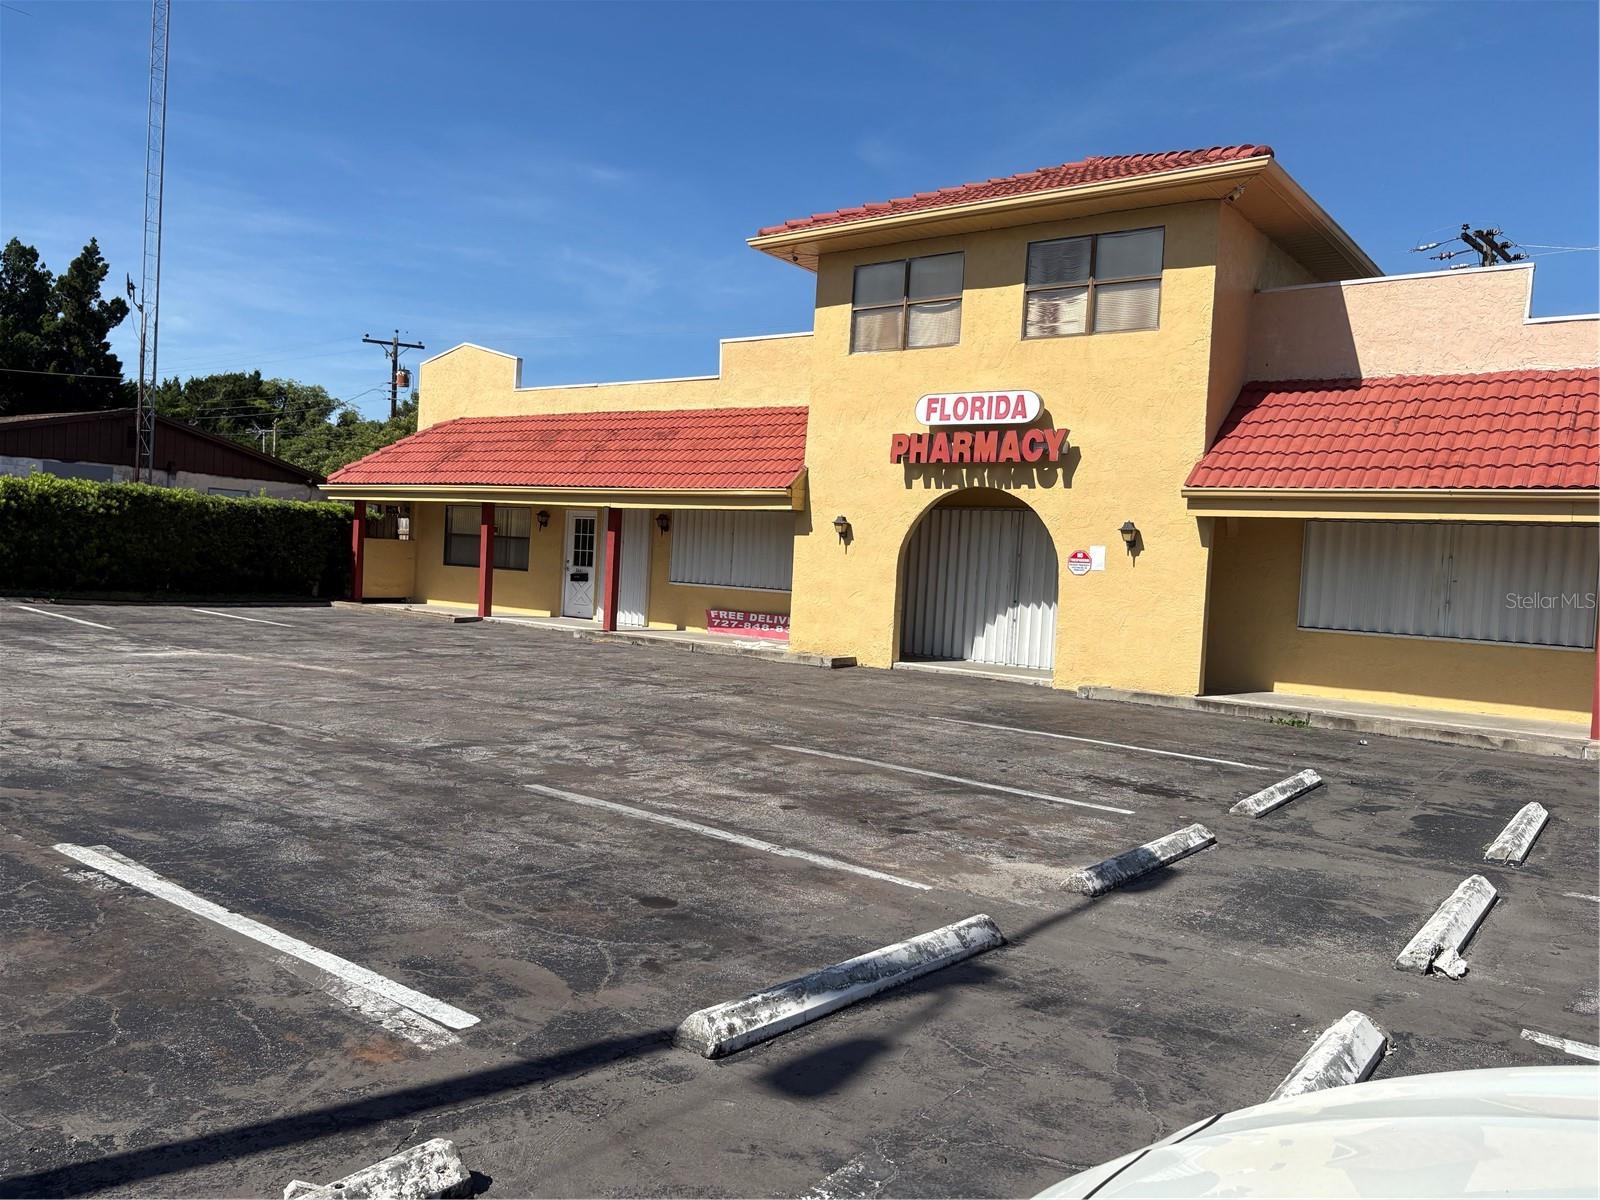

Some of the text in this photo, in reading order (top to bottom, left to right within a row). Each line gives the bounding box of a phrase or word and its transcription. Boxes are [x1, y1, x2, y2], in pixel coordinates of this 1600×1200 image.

[925, 394, 1028, 421] FLORIDA
[890, 428, 1070, 464] PHARMACY
[710, 610, 744, 621] FREE
